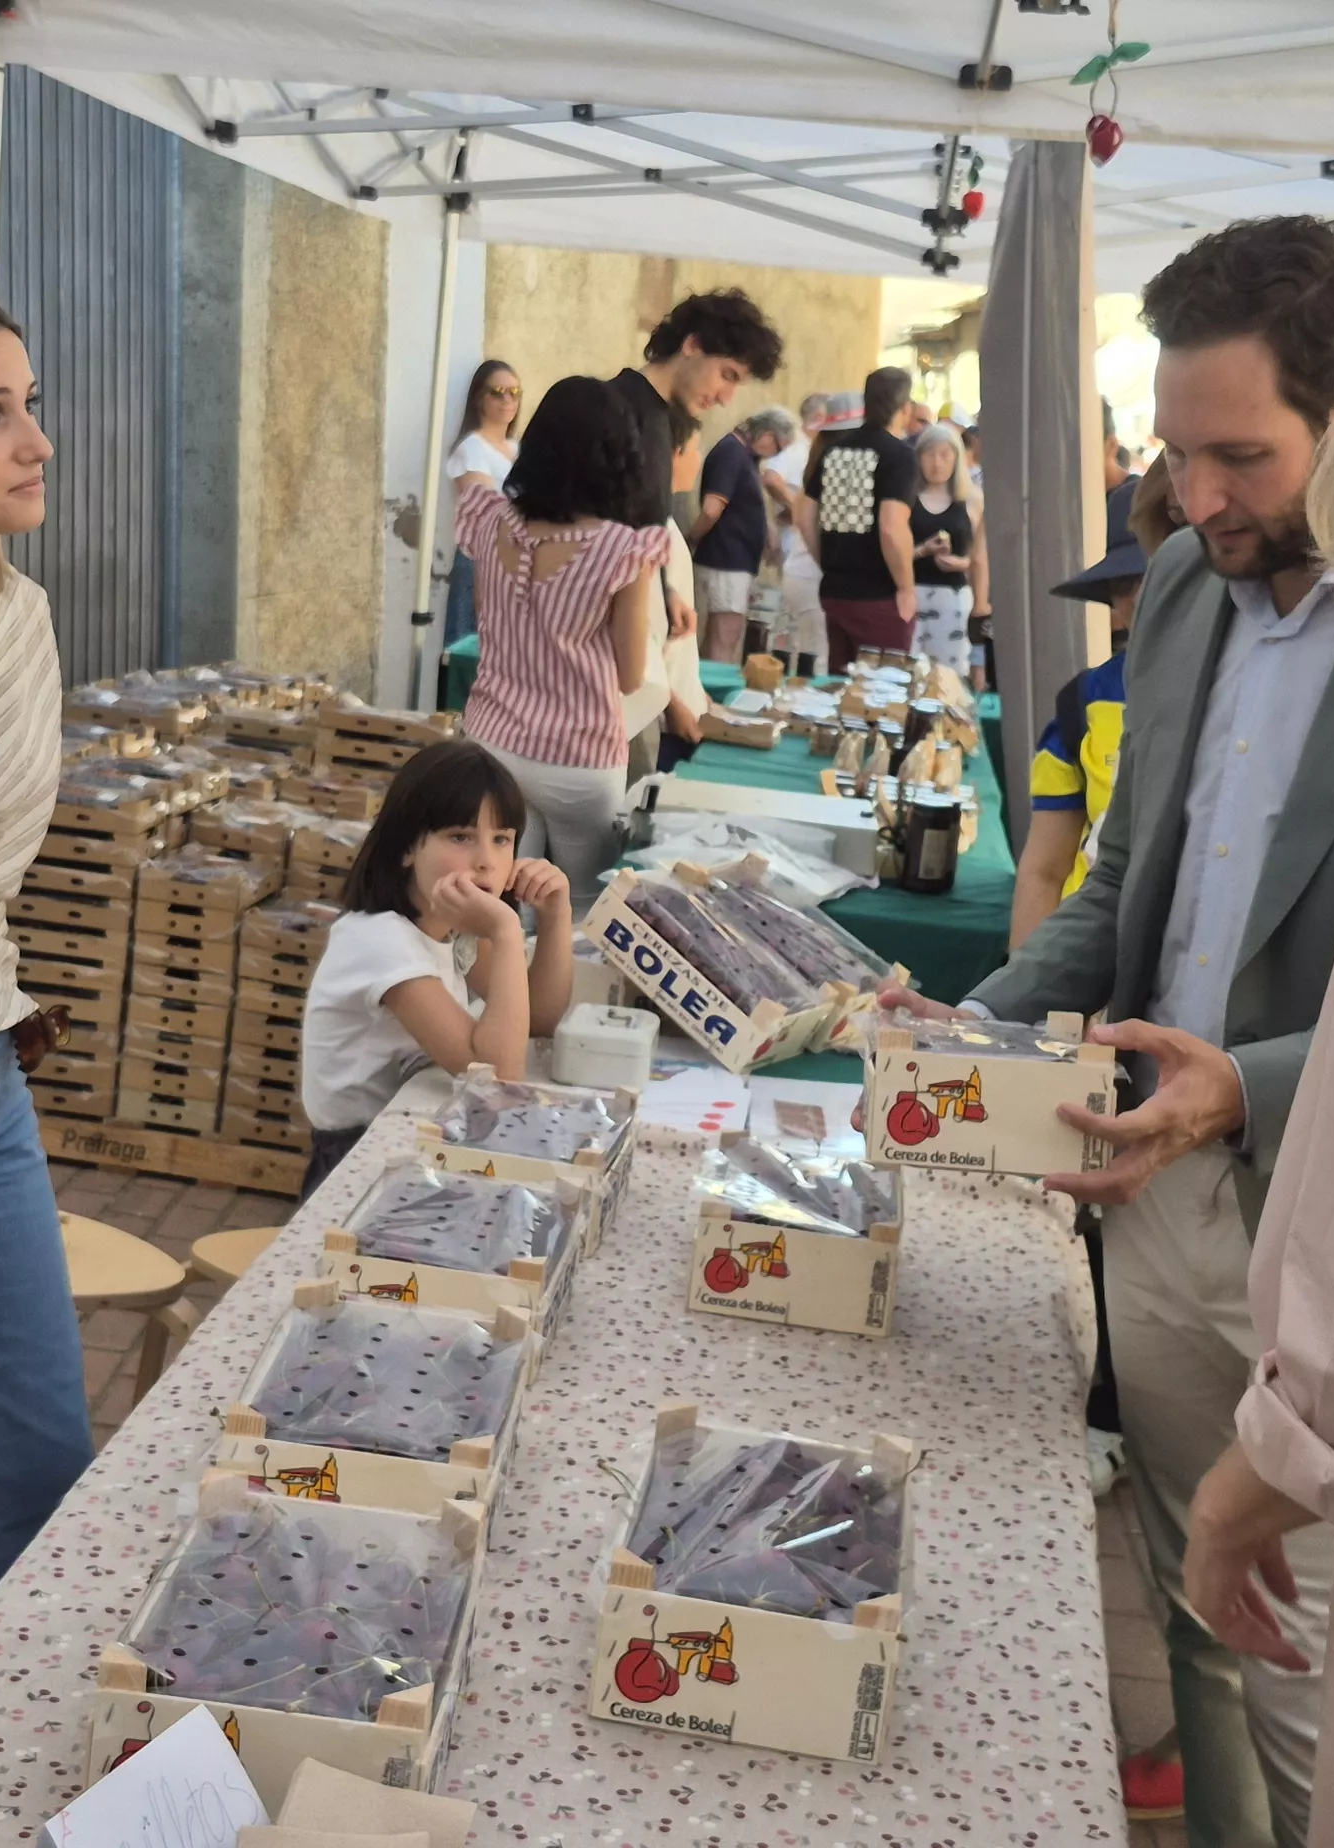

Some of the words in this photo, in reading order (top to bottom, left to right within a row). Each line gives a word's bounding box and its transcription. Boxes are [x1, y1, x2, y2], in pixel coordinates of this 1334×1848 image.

[603, 918, 738, 1046] BOLEA
[632, 921, 701, 988] CEREZAS
[705, 987, 730, 1013] DE
[884, 1147, 927, 1162] Cereza
[930, 1150, 947, 1163] de
[949, 1151, 985, 1166] Bolea
[700, 1293, 738, 1308] Cereza
[739, 1299, 753, 1310] de
[755, 1300, 786, 1315] Bolea
[609, 1702, 663, 1724] Cereza
[665, 1711, 686, 1728] de
[689, 1715, 732, 1736] Bolea
